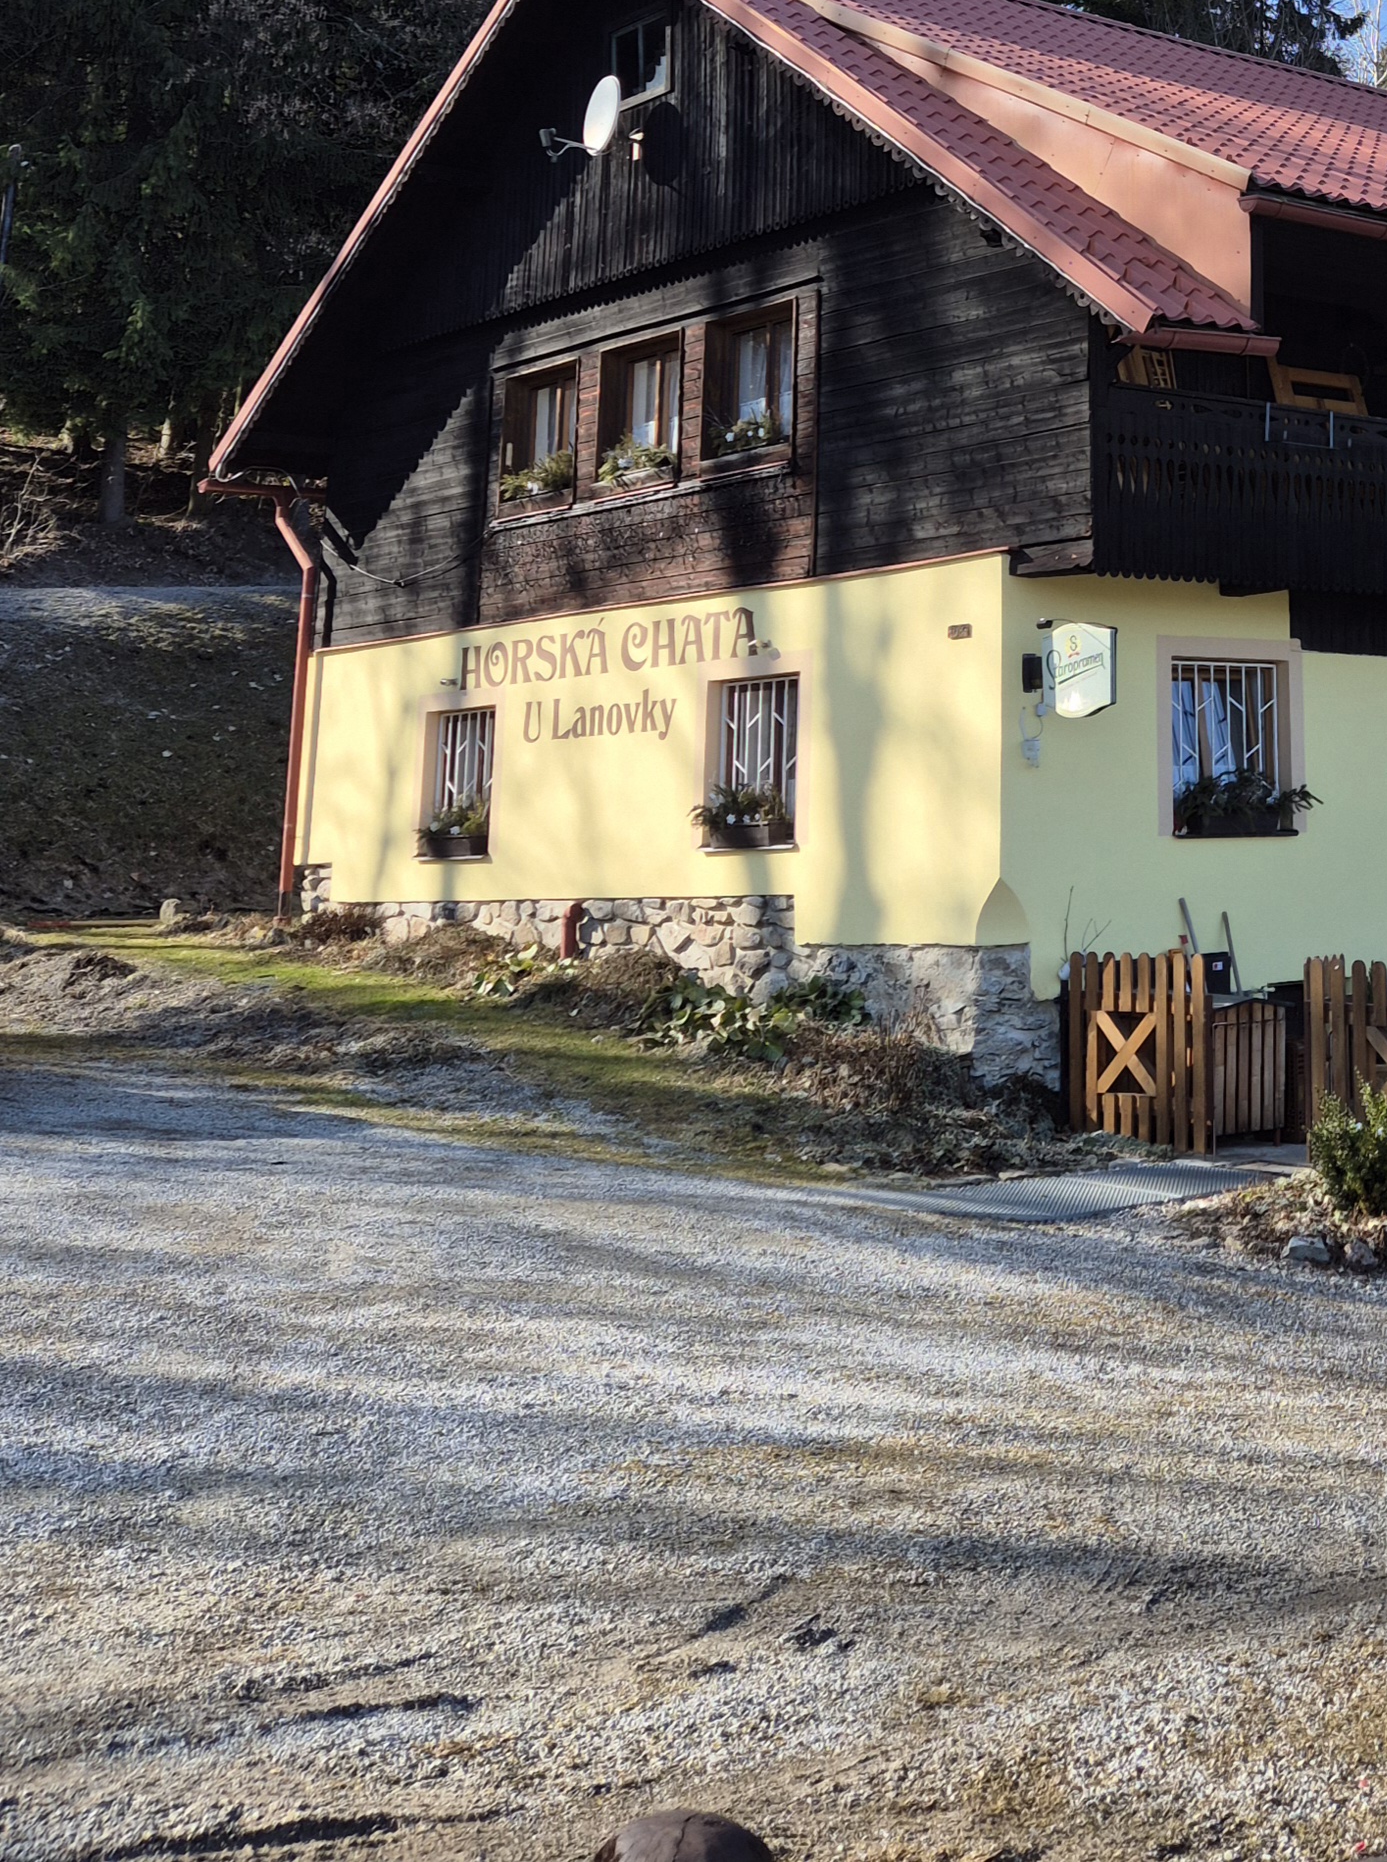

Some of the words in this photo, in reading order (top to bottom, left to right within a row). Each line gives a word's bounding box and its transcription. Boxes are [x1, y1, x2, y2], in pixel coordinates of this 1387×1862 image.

[460, 617, 609, 691] HORSKÁ
[621, 607, 758, 672] CHATA
[1046, 649, 1105, 690] Staropramen
[523, 701, 542, 743] U
[551, 688, 677, 741] Lanovky
